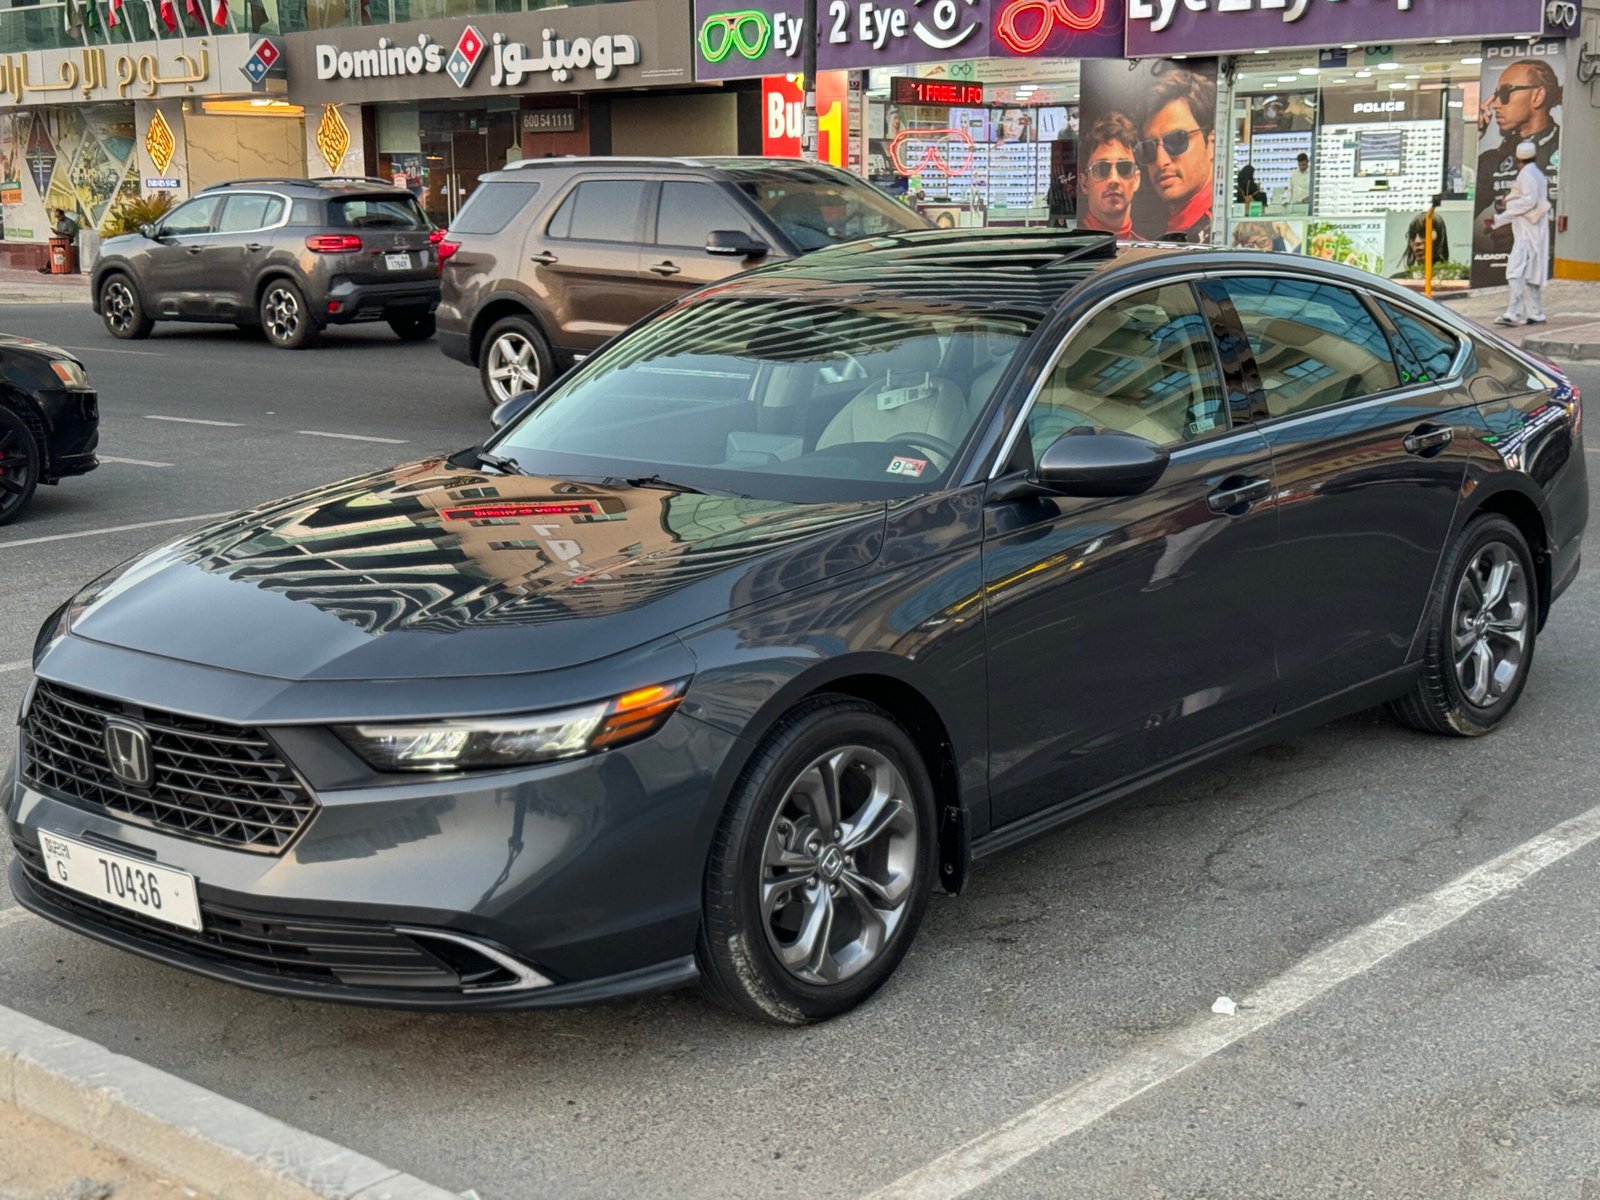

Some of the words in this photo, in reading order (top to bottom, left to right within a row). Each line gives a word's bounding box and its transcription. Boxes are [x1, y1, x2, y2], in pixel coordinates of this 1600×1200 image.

[774, 12, 804, 57] Ey
[829, 1, 847, 43] 2
[860, 3, 906, 50] Eye
[1487, 44, 1558, 58] POLICE
[116, 39, 209, 98] نجوم
[316, 33, 444, 79] Domino's
[490, 28, 638, 87] دومينوز
[768, 92, 802, 138] Bu
[1353, 101, 1405, 113] POLICE
[891, 461, 901, 471] 9
[57, 860, 68, 881] G
[98, 858, 162, 910] 70436
